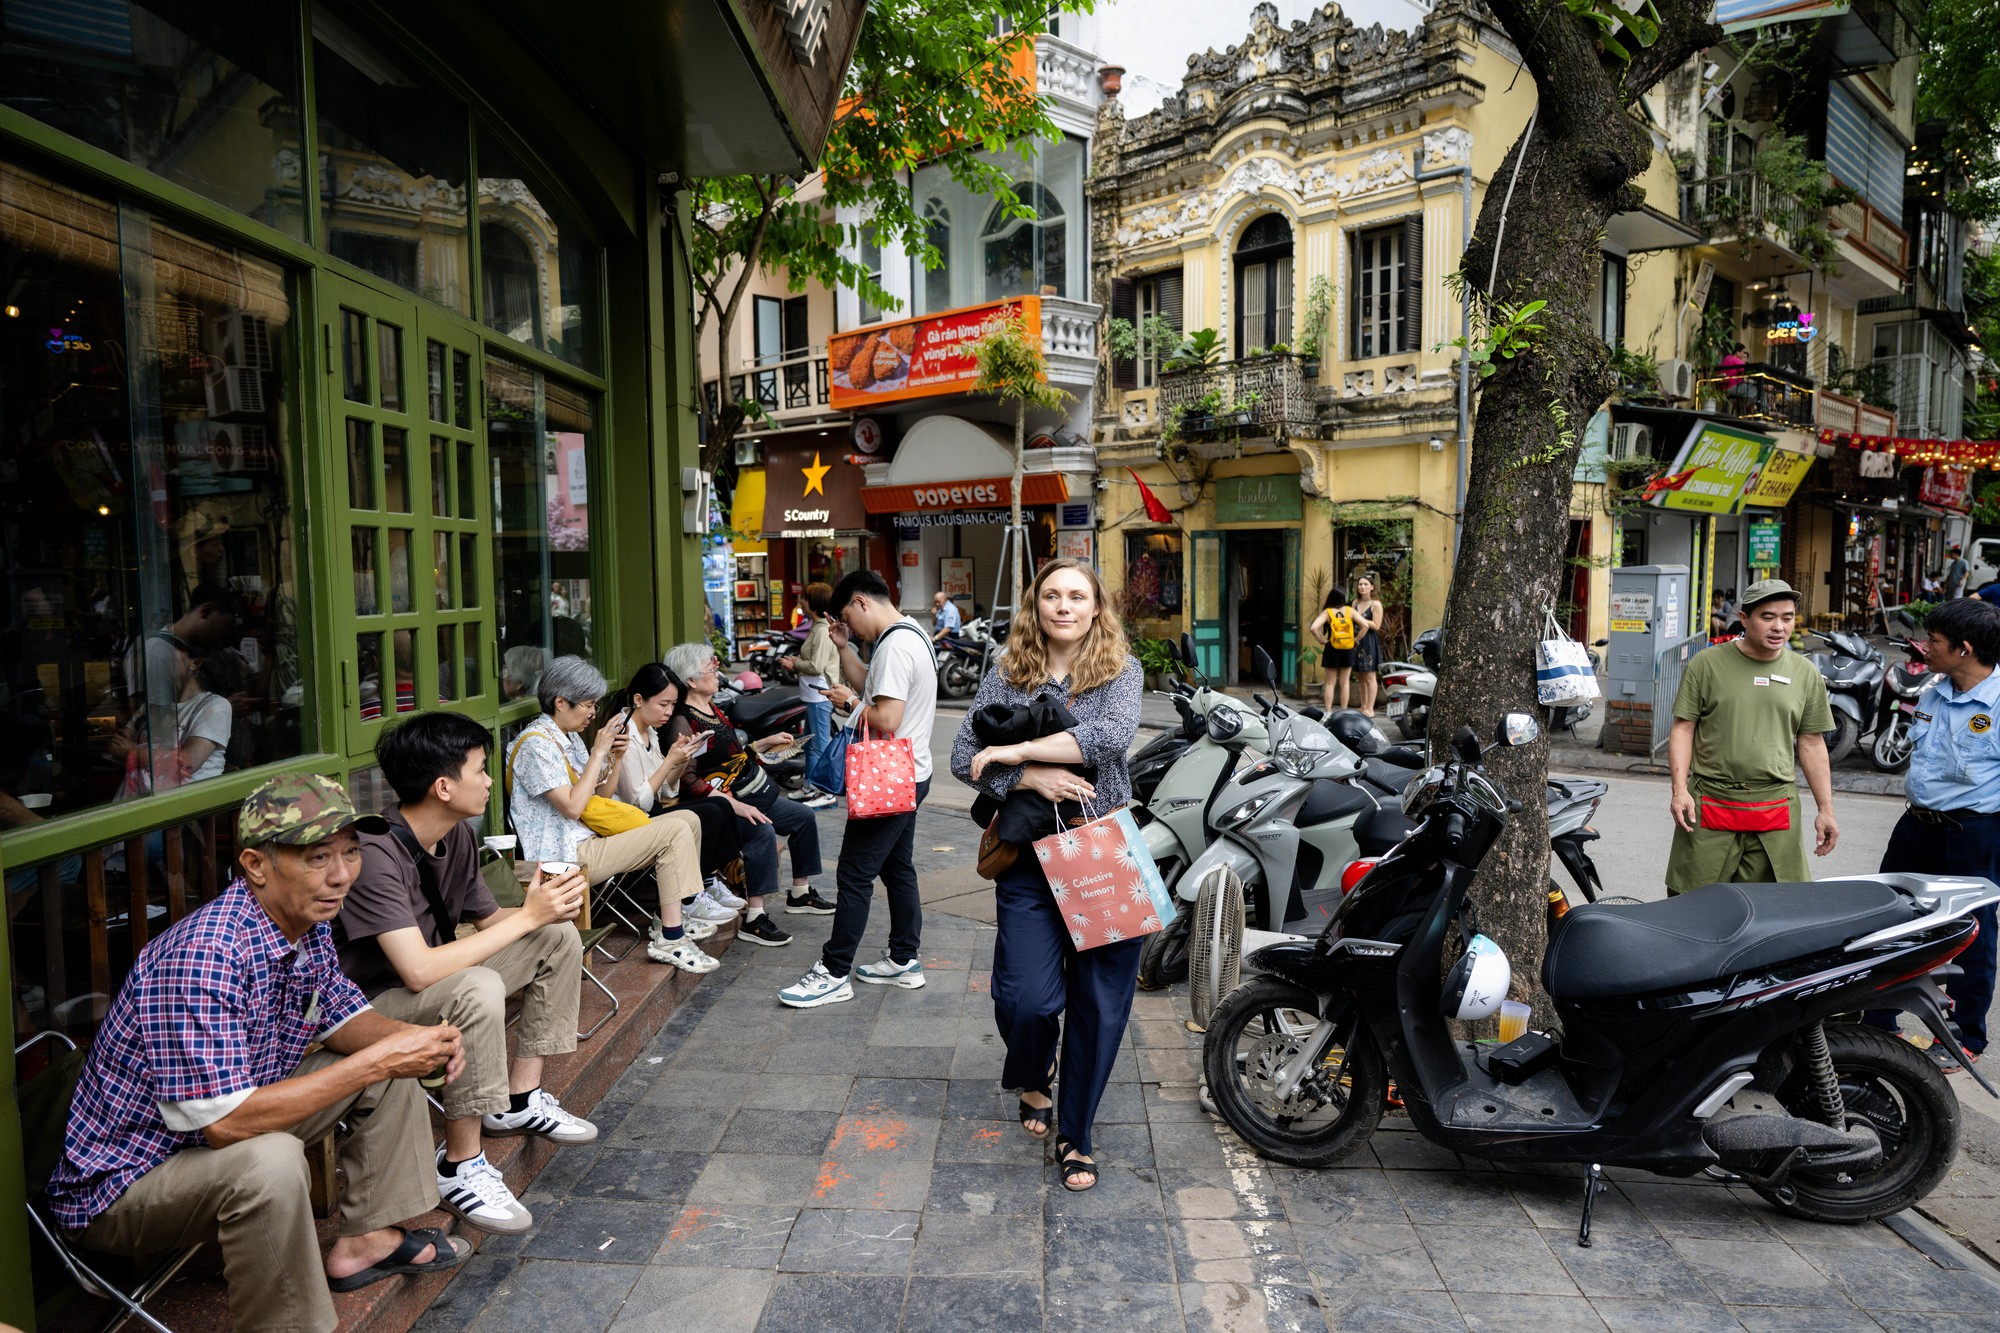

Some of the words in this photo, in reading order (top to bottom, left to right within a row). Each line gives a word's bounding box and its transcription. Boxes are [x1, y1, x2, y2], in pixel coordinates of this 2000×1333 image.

[927, 329, 940, 344] Gà
[940, 326, 957, 342] rán
[923, 346, 947, 361] vùng
[683, 467, 711, 534] 27
[893, 515, 932, 528] FAMOUS
[933, 512, 985, 526] LOUISIANA
[987, 510, 1035, 525] CHICEN
[1072, 871, 1113, 888] Collective
[1080, 885, 1115, 900] Memory
[1103, 909, 1112, 918] 12
